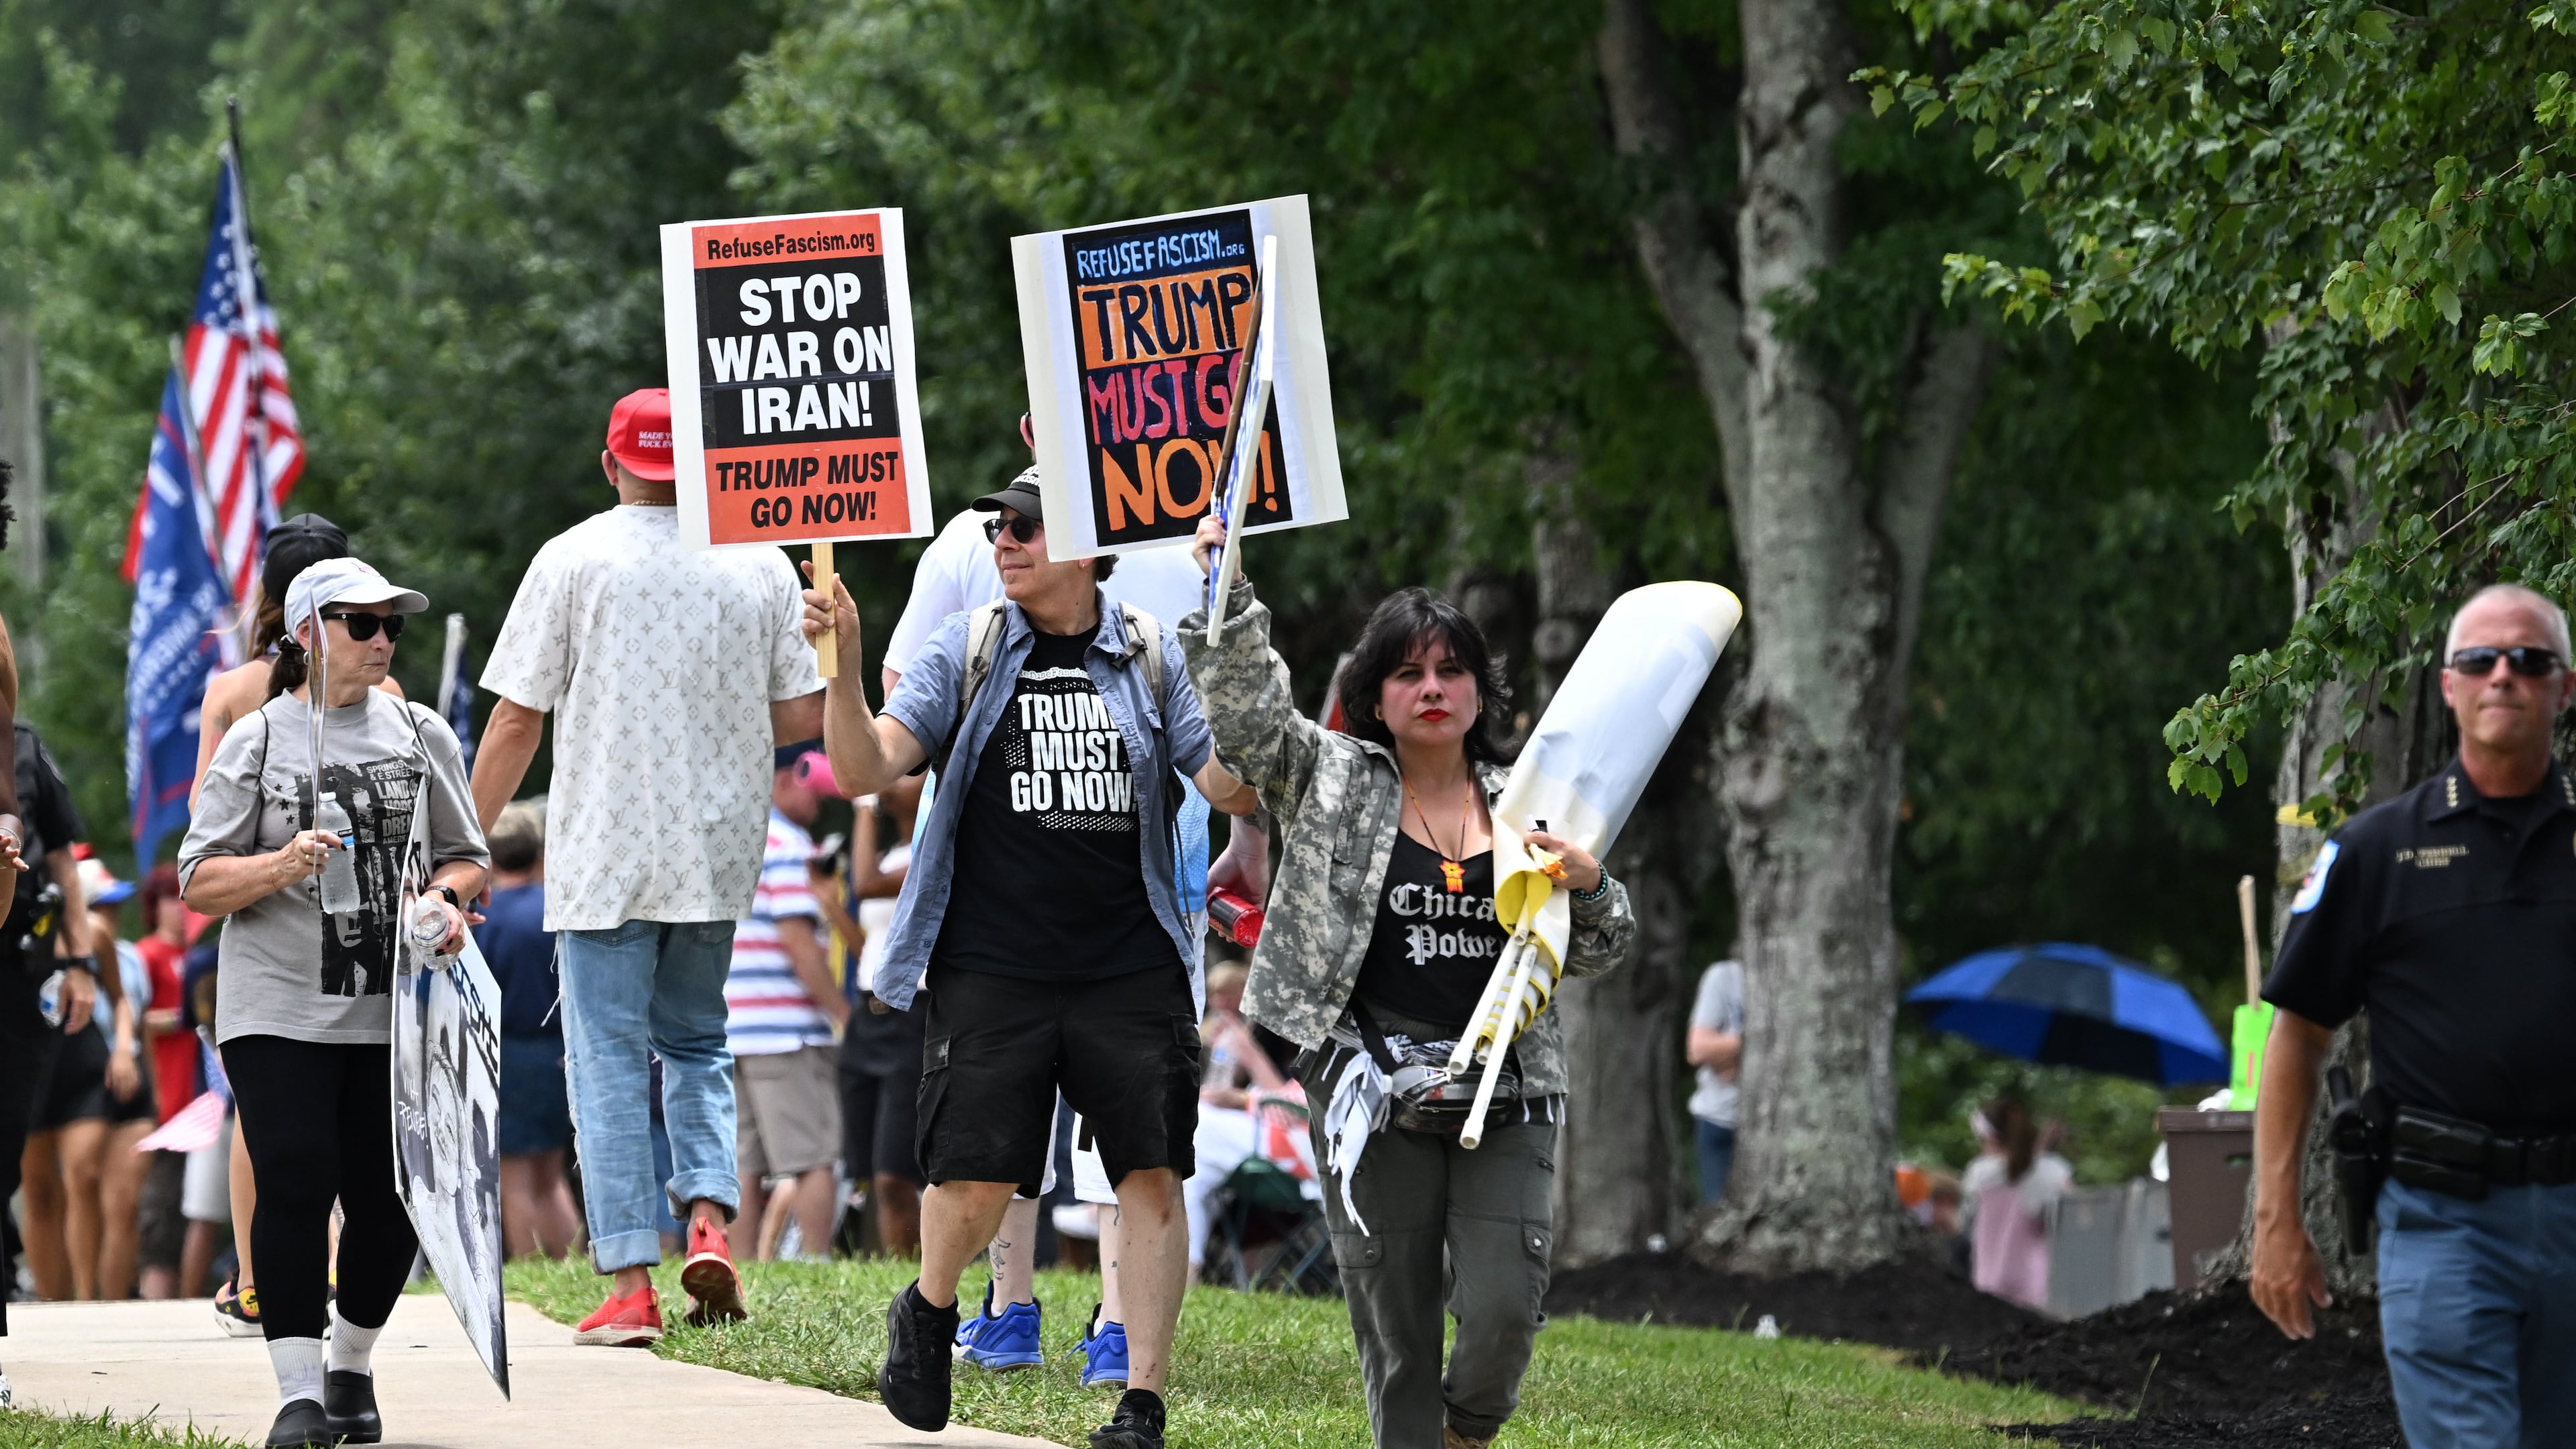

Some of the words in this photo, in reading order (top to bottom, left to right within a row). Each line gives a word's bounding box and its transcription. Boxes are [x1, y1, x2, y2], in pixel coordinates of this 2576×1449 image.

[708, 231, 875, 260] RefuseFascism.org
[739, 272, 861, 326] STOP
[1083, 273, 1251, 362] TRUMP
[706, 331, 822, 383] WAR
[833, 325, 892, 374] ON
[741, 381, 872, 435] IRAN!
[1087, 360, 1189, 445] MUST
[1195, 351, 1241, 429] G
[716, 457, 819, 492] TRUMP
[828, 451, 898, 484] MUST
[751, 496, 792, 528] GO
[802, 492, 876, 525] NOW!
[1018, 692, 1119, 731] TRUM
[1030, 731, 1120, 771] MUST
[375, 780, 410, 799] LAND
[378, 772, 384, 780] E
[1010, 771, 1053, 812] GO
[1389, 882, 1495, 922] Chica
[1405, 924, 1505, 965] Powe
